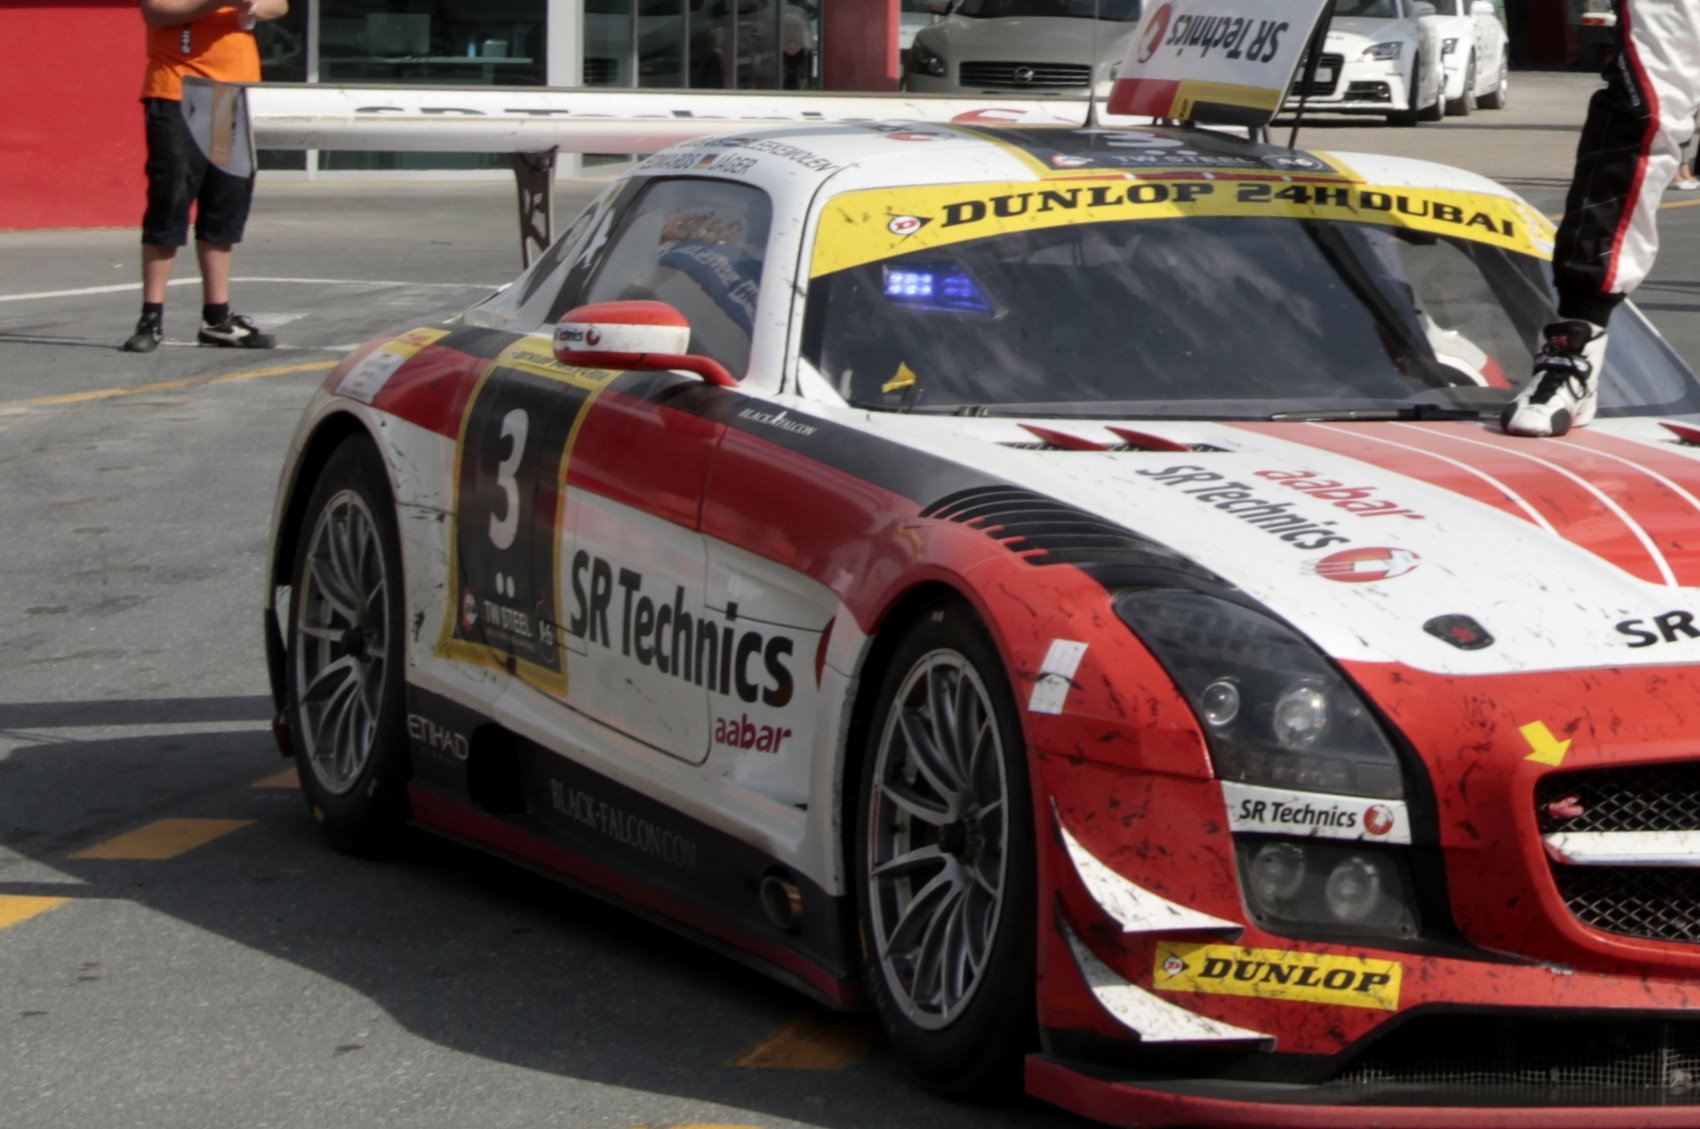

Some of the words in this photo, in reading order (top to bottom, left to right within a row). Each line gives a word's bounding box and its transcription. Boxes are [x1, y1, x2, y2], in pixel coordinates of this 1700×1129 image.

[1166, 14, 1252, 62] Technics
[1250, 19, 1290, 63] SR
[940, 182, 1215, 229] DUNLOP
[1236, 182, 1350, 207] 24H
[1359, 190, 1515, 238] DUBAI
[488, 407, 530, 551] 3
[1252, 468, 1426, 521] aabar
[1134, 464, 1215, 494] SR
[1199, 479, 1351, 551] Technics
[570, 548, 614, 648] SR
[618, 567, 794, 708] Technics
[406, 712, 469, 761] ETIHAD
[715, 711, 793, 754] aabar
[1238, 798, 1266, 823] SR
[1269, 801, 1357, 829] Technics
[1197, 956, 1392, 993] DUNLOP
